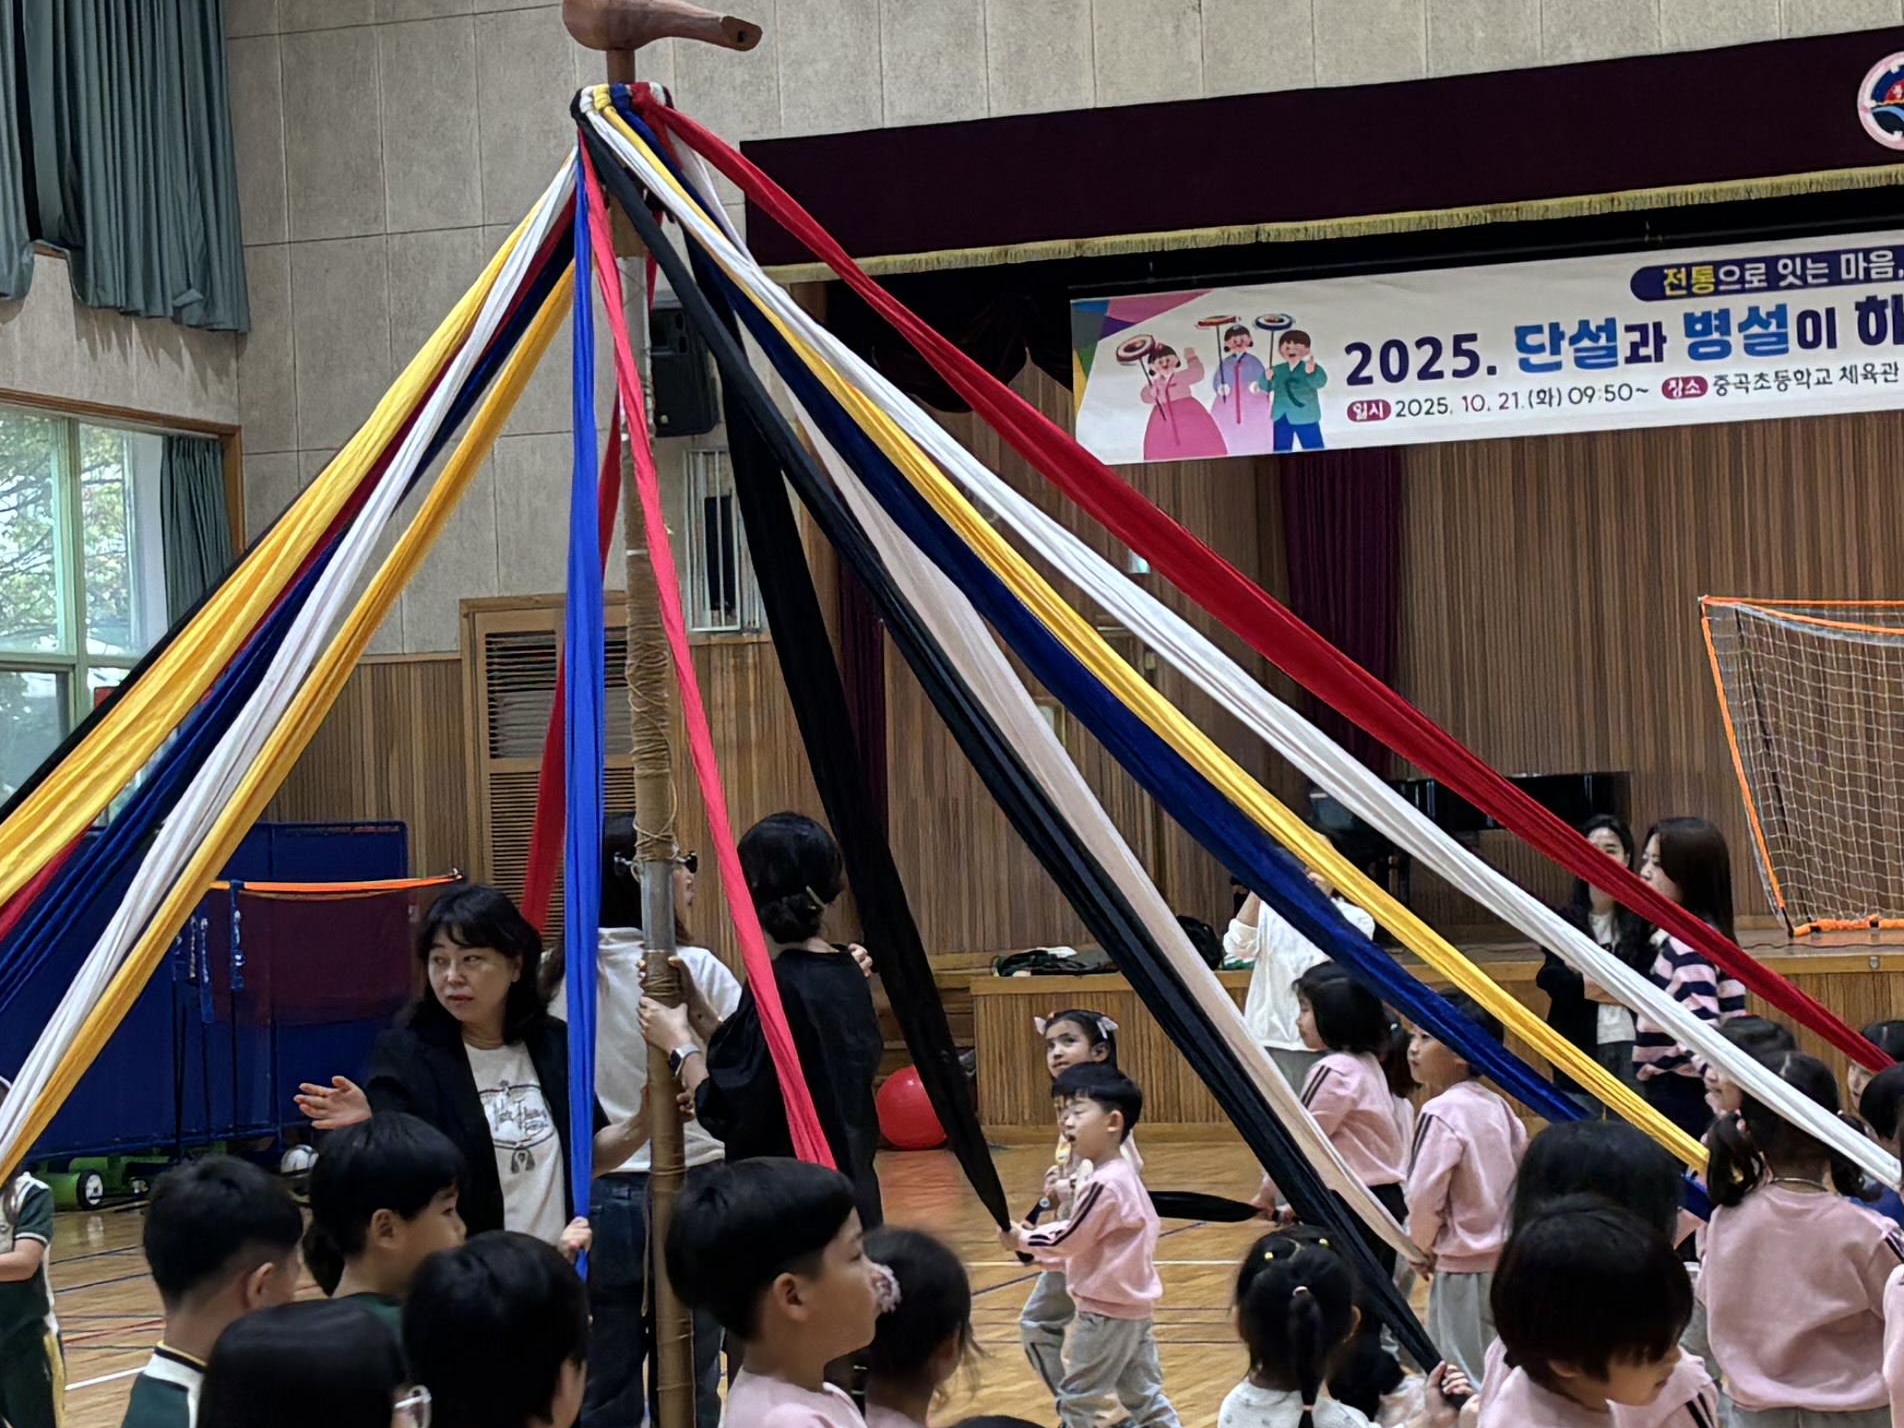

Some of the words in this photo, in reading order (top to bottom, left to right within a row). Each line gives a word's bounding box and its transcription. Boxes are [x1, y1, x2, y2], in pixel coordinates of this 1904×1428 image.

[1663, 263, 1768, 297] 전통으로
[1777, 257, 1829, 287] 잇는
[1840, 249, 1904, 280] 마음,
[1344, 333, 1498, 386] 2025.
[1514, 316, 1667, 374] 단설과
[1683, 303, 1838, 361] 병설이
[1350, 400, 1385, 421] 일시
[1395, 396, 1453, 418] 2025.
[1461, 393, 1491, 414] 10.
[1713, 367, 1833, 397] 중곡초등학교
[1839, 361, 1900, 386] 체육관
